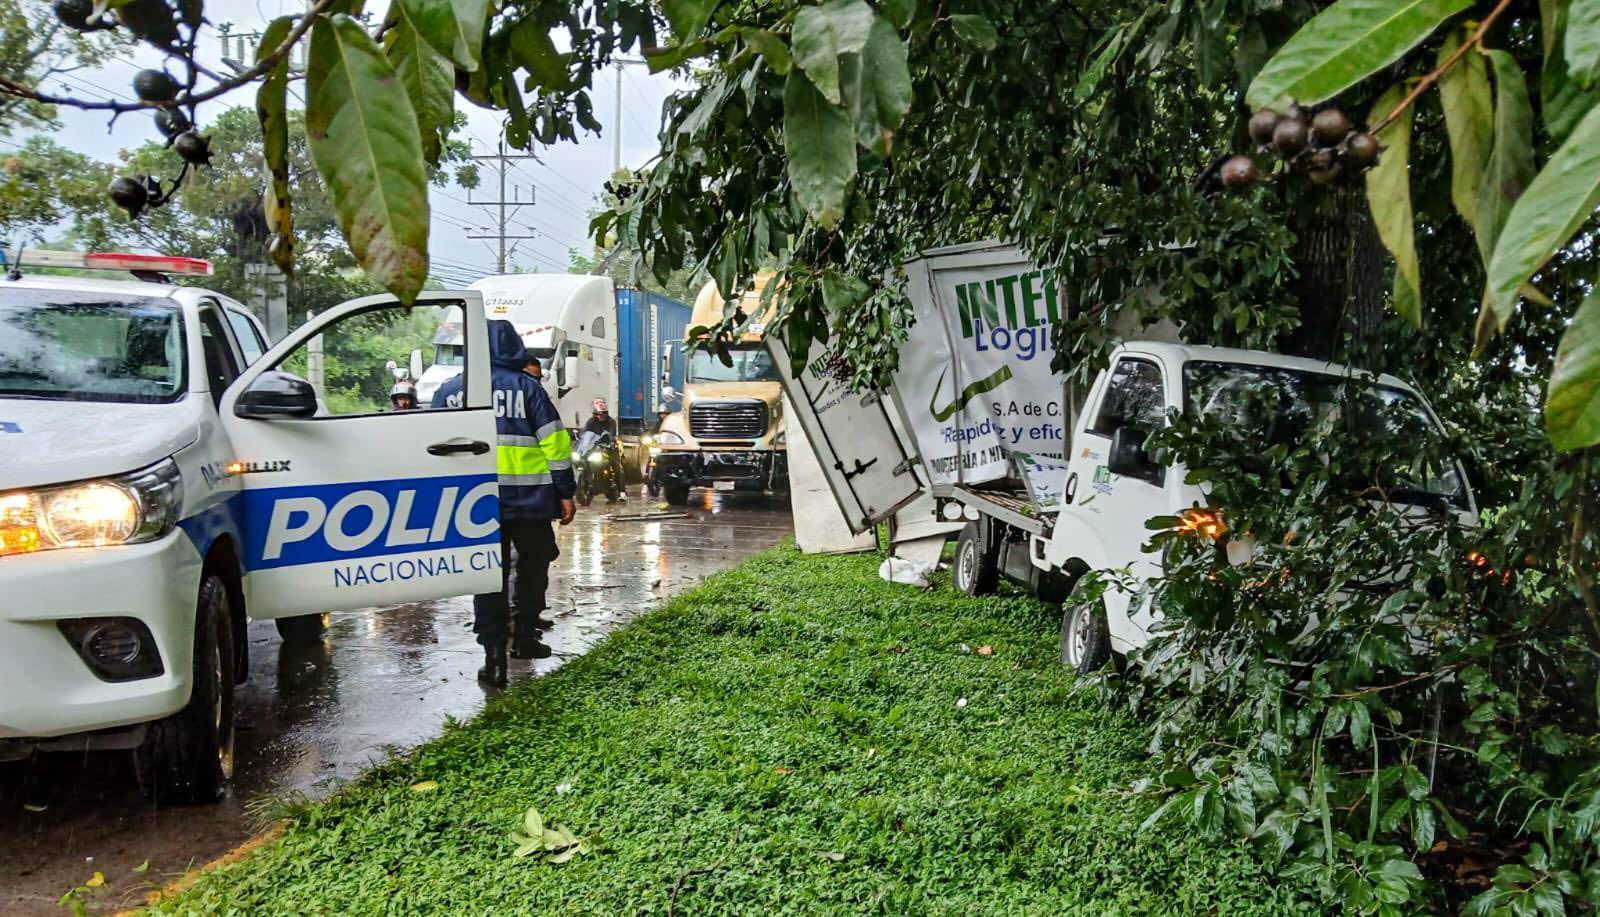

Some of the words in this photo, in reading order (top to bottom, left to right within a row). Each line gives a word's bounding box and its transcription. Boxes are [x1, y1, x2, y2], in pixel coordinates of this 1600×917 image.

[1023, 402, 1042, 416] de
[1011, 427, 1023, 444] y
[334, 554, 463, 588] NACIONAL
